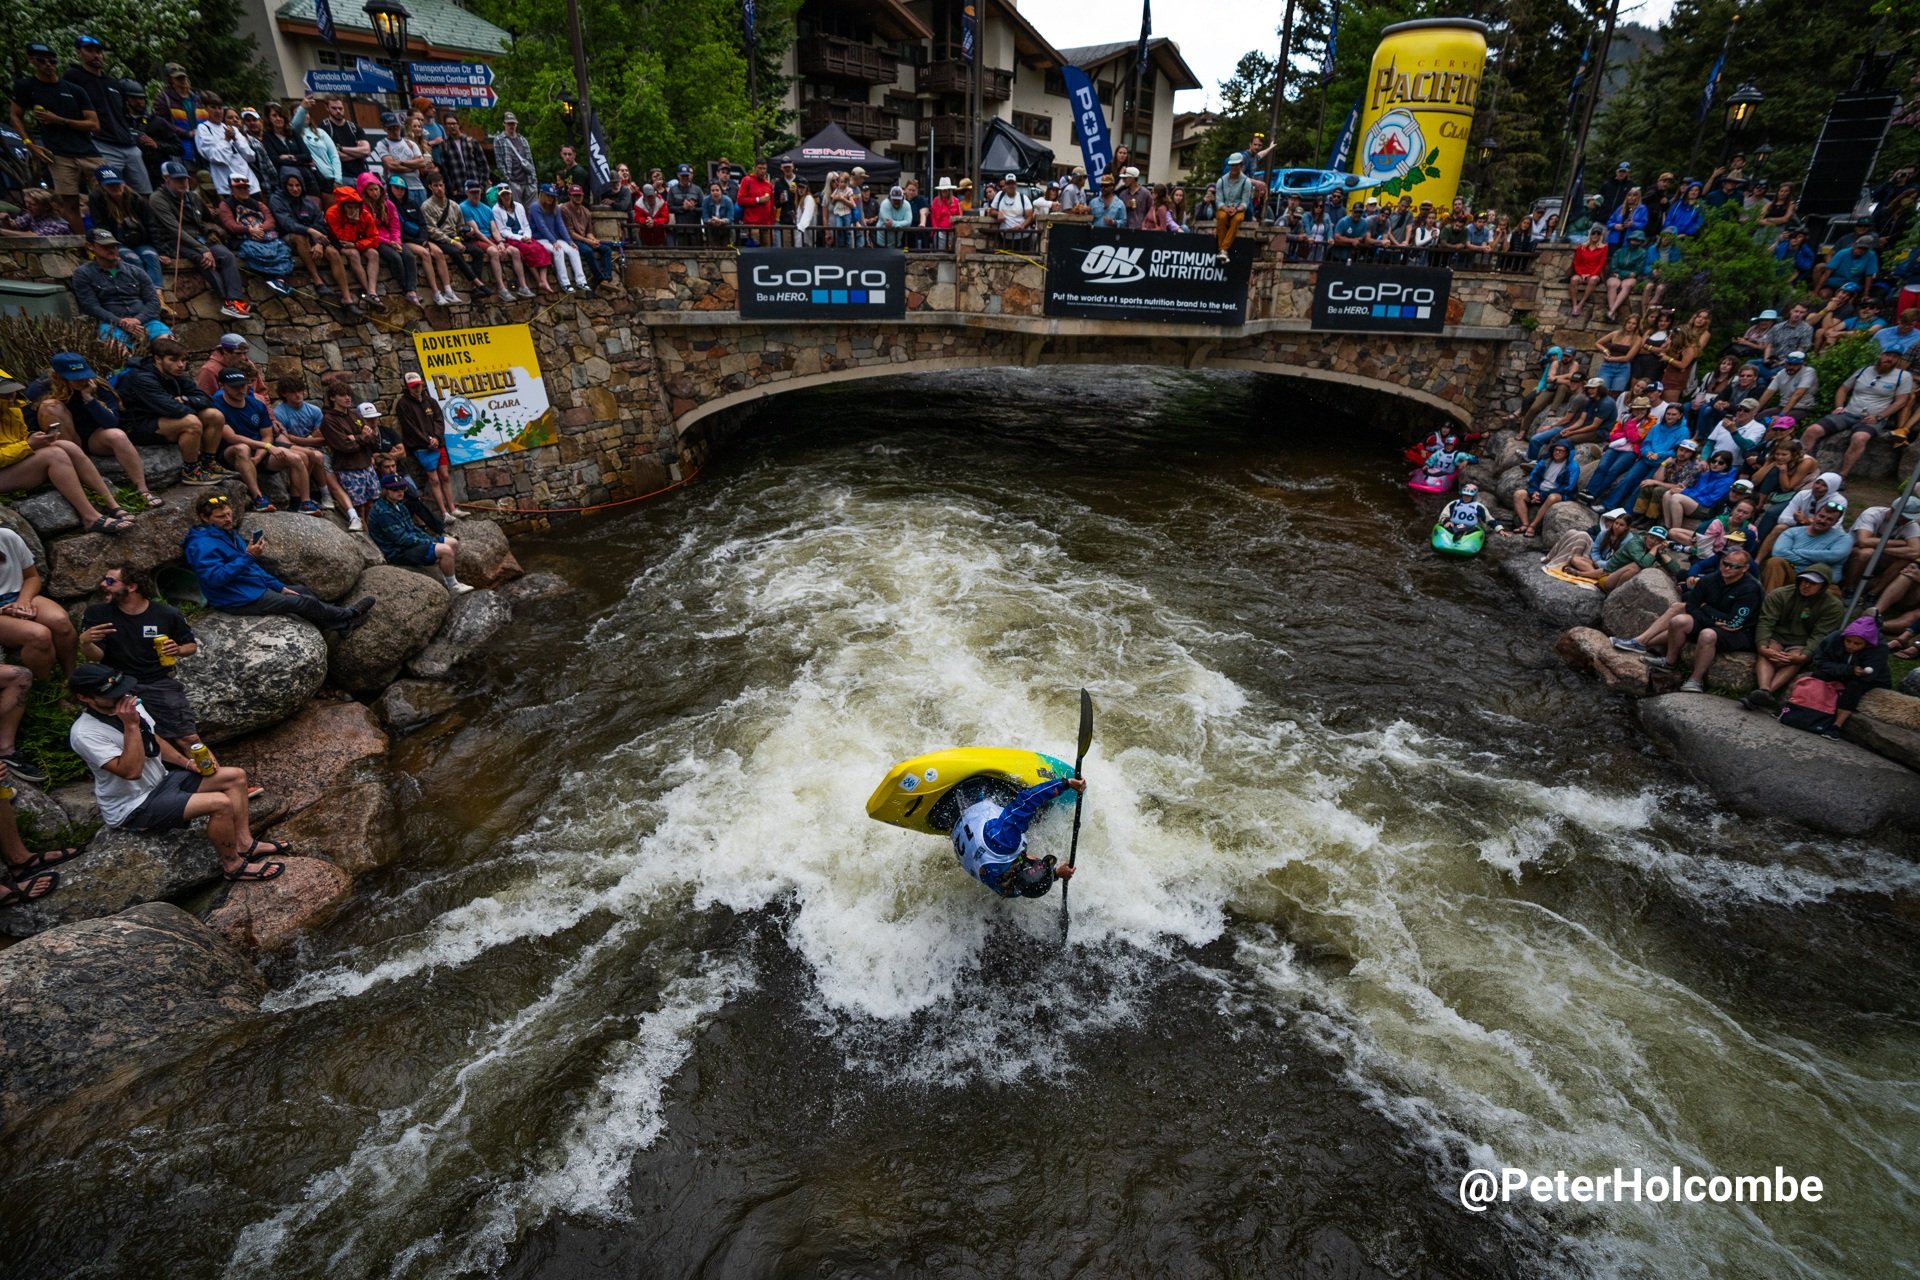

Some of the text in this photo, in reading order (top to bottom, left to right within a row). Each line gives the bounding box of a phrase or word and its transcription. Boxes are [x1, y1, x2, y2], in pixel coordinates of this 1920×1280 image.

[412, 63, 471, 74] Transportation Ctr
[313, 72, 356, 82] Gondola One
[414, 74, 468, 83] Welcome Center
[315, 82, 352, 91] Restrooms
[416, 86, 471, 97] Lionshead Village
[1371, 65, 1479, 110] PACIFIC
[435, 96, 455, 106] Valley
[456, 97, 472, 106] Trail
[1076, 86, 1107, 184] POLA
[802, 148, 866, 156] GMC
[1080, 245, 1145, 280] ON
[1151, 249, 1217, 267] OPTIMUM
[753, 265, 887, 287] GoPro
[1150, 263, 1224, 282] NUTRITION
[756, 293, 768, 301] Be
[776, 292, 808, 301] HERO.
[1327, 281, 1435, 304] GoPro
[1053, 292, 1065, 300] Put
[1066, 293, 1079, 301] the
[1081, 295, 1107, 303] world's
[1109, 295, 1118, 303] #1
[1120, 297, 1143, 305] sports
[1144, 298, 1175, 307] nutrition
[1176, 300, 1198, 308] brand
[1208, 301, 1221, 309] the
[1222, 302, 1238, 310] test.
[1327, 306, 1337, 314] Be
[1343, 306, 1370, 315] HERO.
[422, 332, 491, 351] ADVENTURE
[427, 351, 476, 368] AWAITS.
[432, 370, 517, 401] PACIFICO
[488, 398, 521, 410] CLARA
[1439, 461, 1451, 469] 17
[1453, 510, 1475, 521] 106
